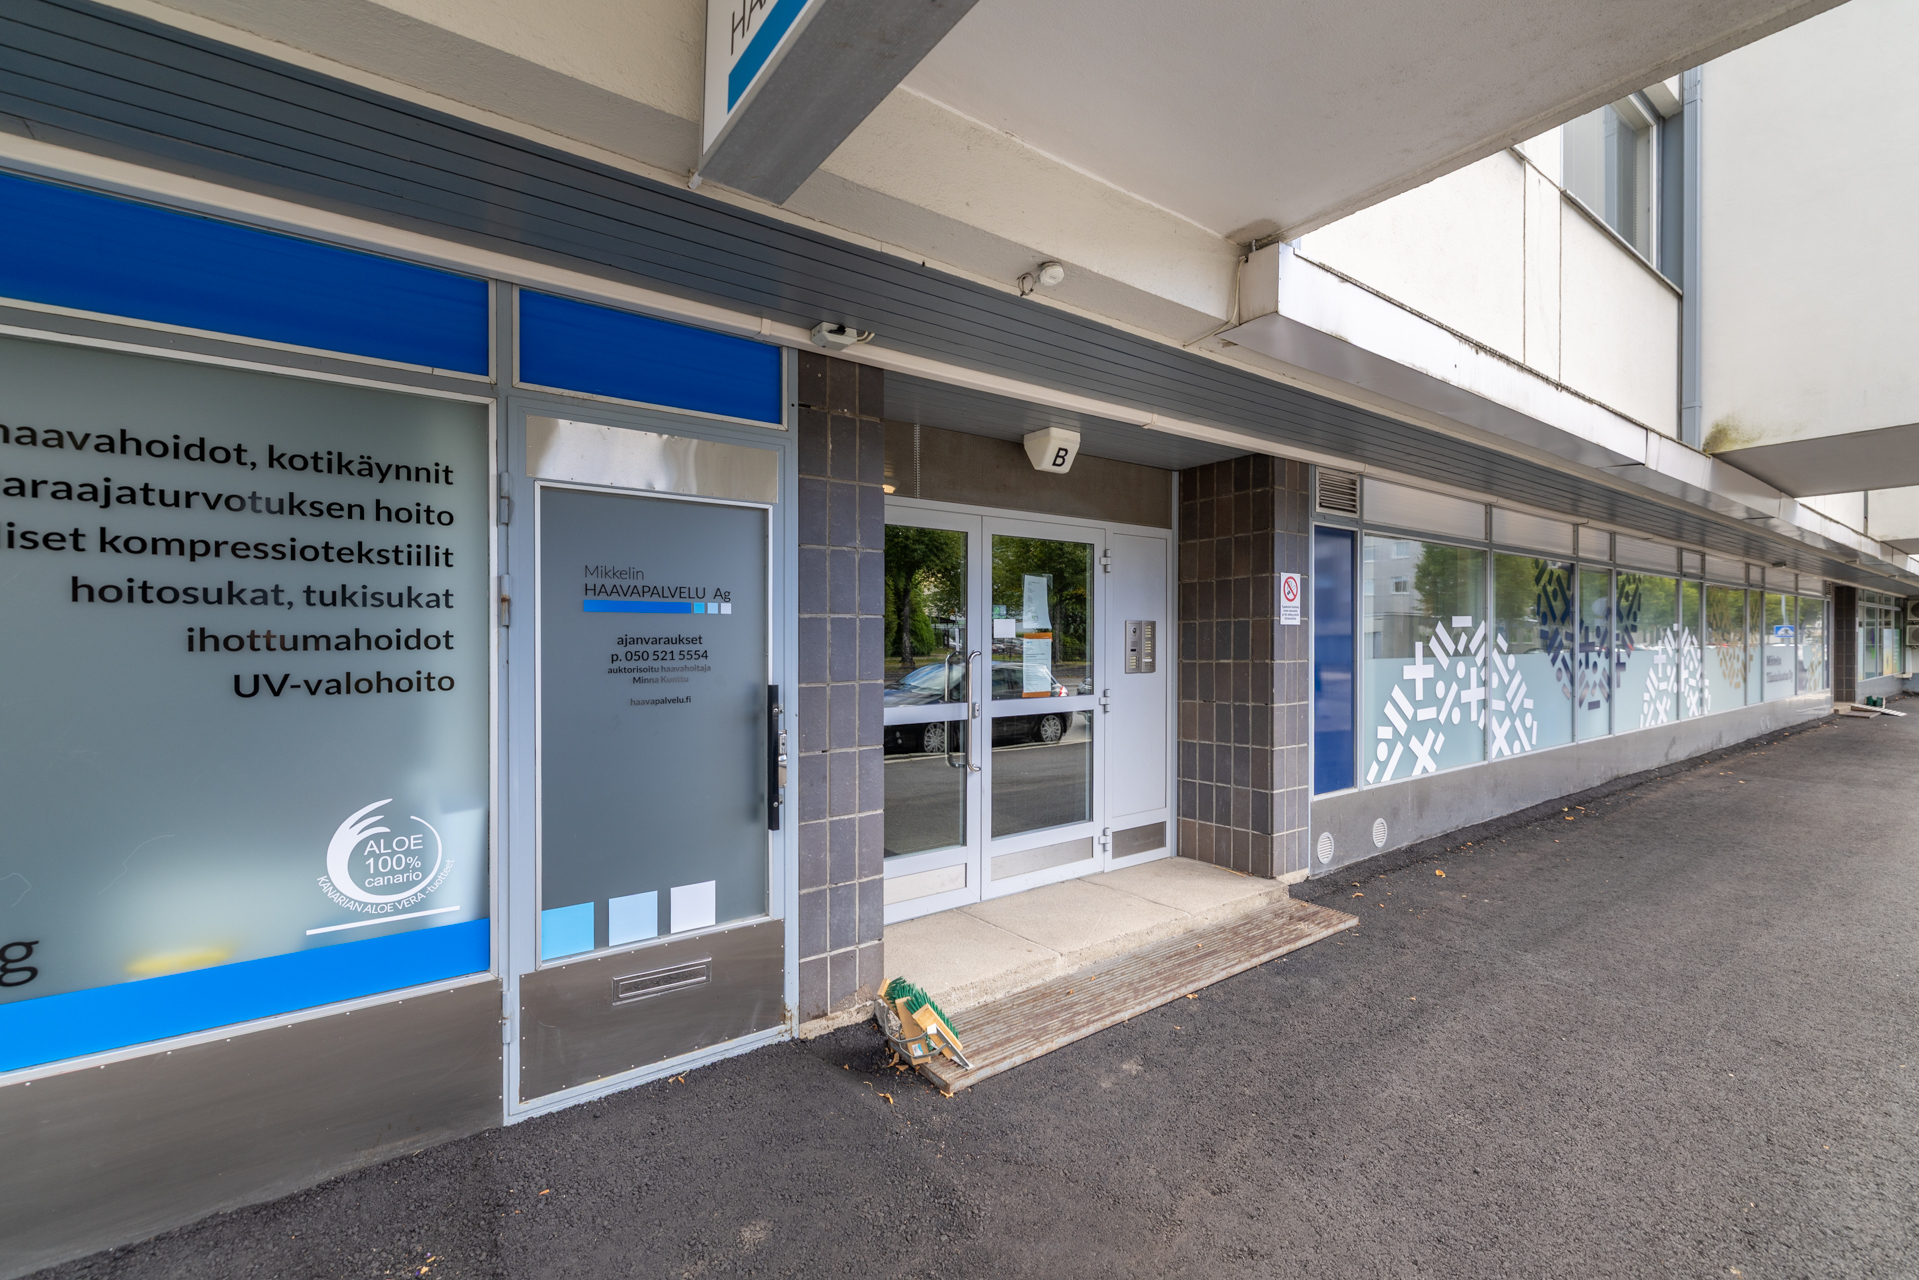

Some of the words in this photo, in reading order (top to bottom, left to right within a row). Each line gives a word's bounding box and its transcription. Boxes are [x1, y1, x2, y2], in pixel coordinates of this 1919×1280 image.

[267, 444, 454, 485] kotikäynnit
[1052, 447, 1069, 467] B
[2, 477, 366, 520] araajaturvotuksen
[374, 499, 455, 526] hoito
[6, 521, 87, 553] iset
[99, 526, 454, 568] kompressiotekstiilit
[584, 565, 645, 580] Mikkelin
[71, 576, 294, 610] hoitosukat,
[302, 583, 454, 609] tukisukat
[584, 583, 706, 600] HAAVAPALVELU
[713, 587, 731, 602] Ag
[187, 627, 455, 652] ihottumahoidot
[616, 634, 703, 647] ajanvaraukset
[610, 652, 622, 664] p.
[624, 650, 650, 662] 050
[652, 650, 676, 661] 521
[678, 649, 709, 661] 5554
[607, 665, 660, 674] auktorisoitu
[660, 663, 712, 673] haavahoitaja
[233, 670, 455, 698] UV-valohoito
[632, 676, 659, 684] Minna
[629, 695, 692, 707] haavapalvelu.fi
[364, 834, 424, 856] ALOE
[365, 854, 422, 874] 100%
[365, 870, 422, 888] canario
[317, 875, 364, 913] KANARIAN
[362, 903, 394, 914] ALOE
[395, 891, 427, 910] VERA
